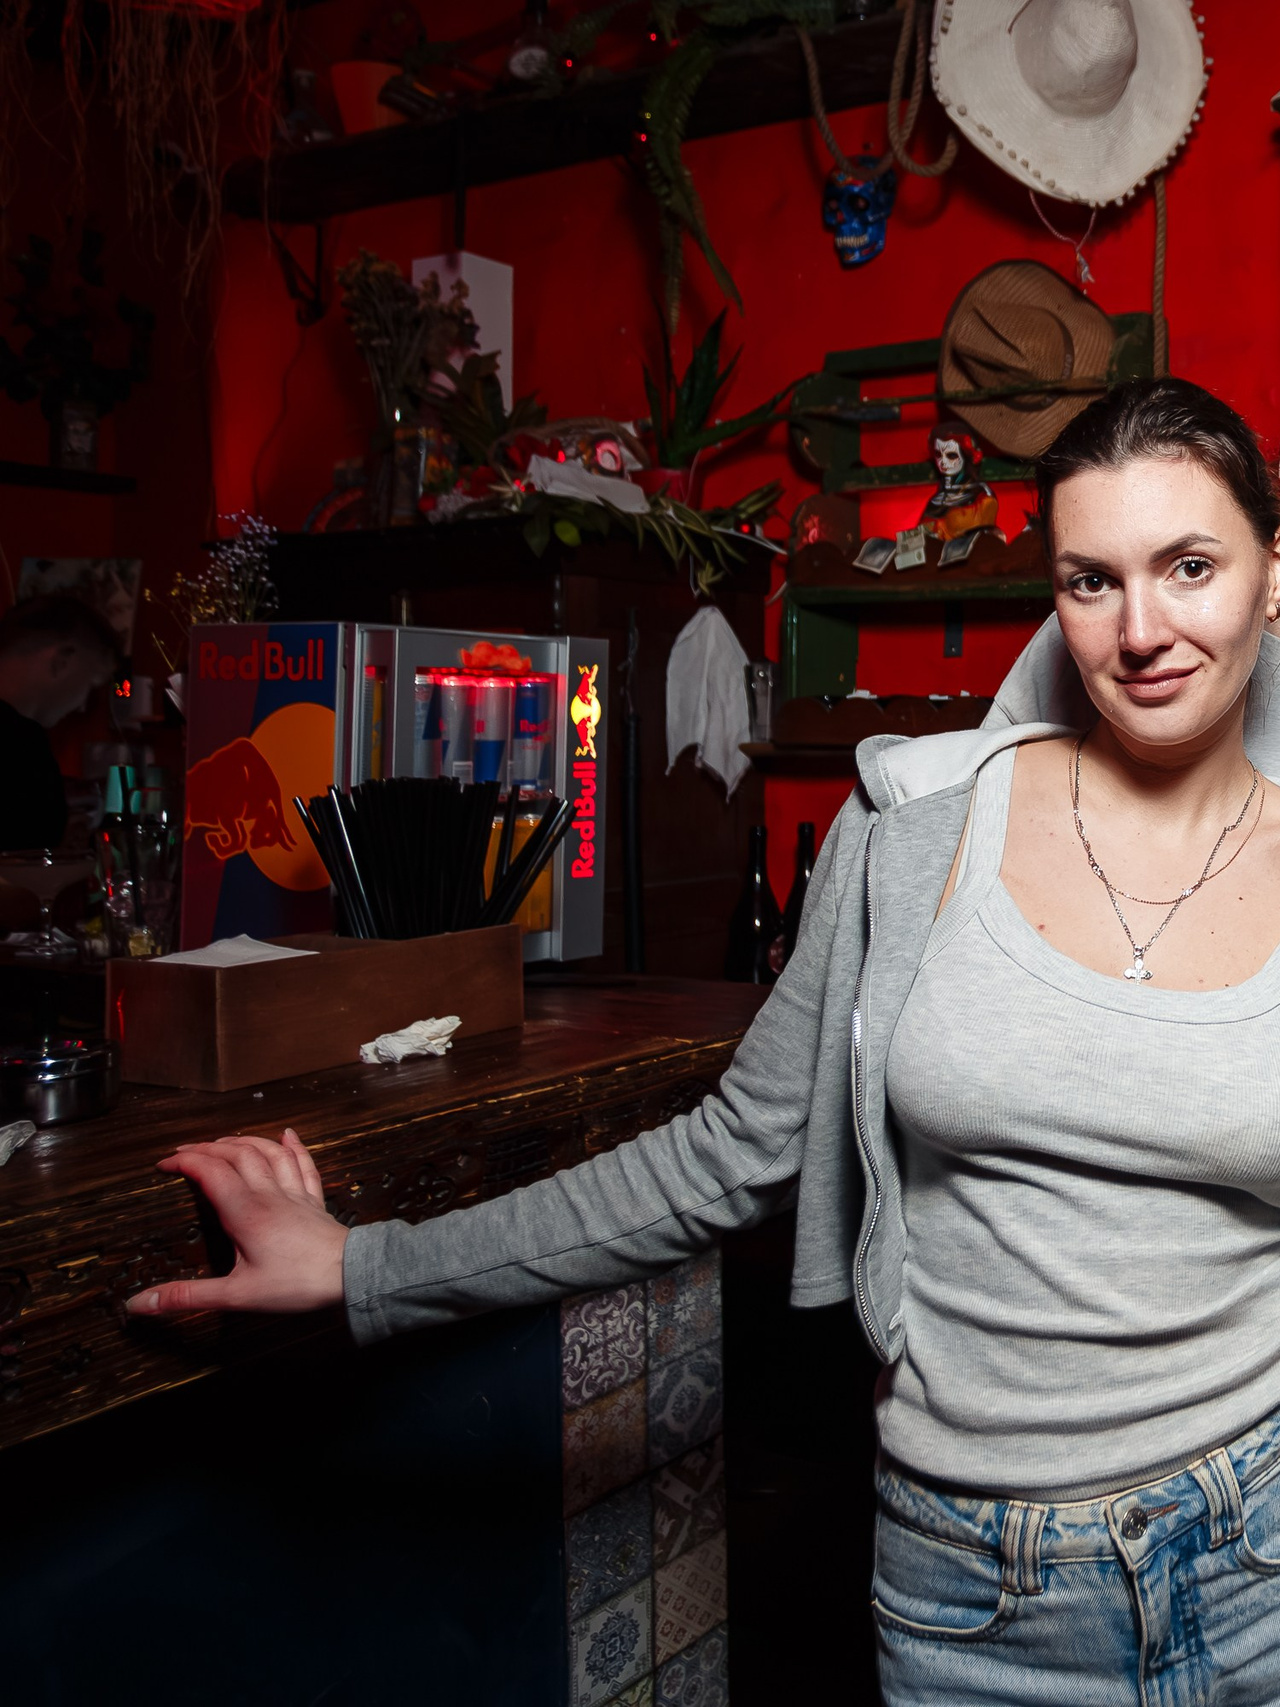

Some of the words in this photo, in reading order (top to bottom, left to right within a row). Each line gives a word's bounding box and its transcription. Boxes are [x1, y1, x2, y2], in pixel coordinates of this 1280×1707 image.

[198, 638, 260, 681] Red
[264, 638, 324, 681] Bull
[573, 761, 596, 817] Bull
[571, 820, 596, 879] Red
